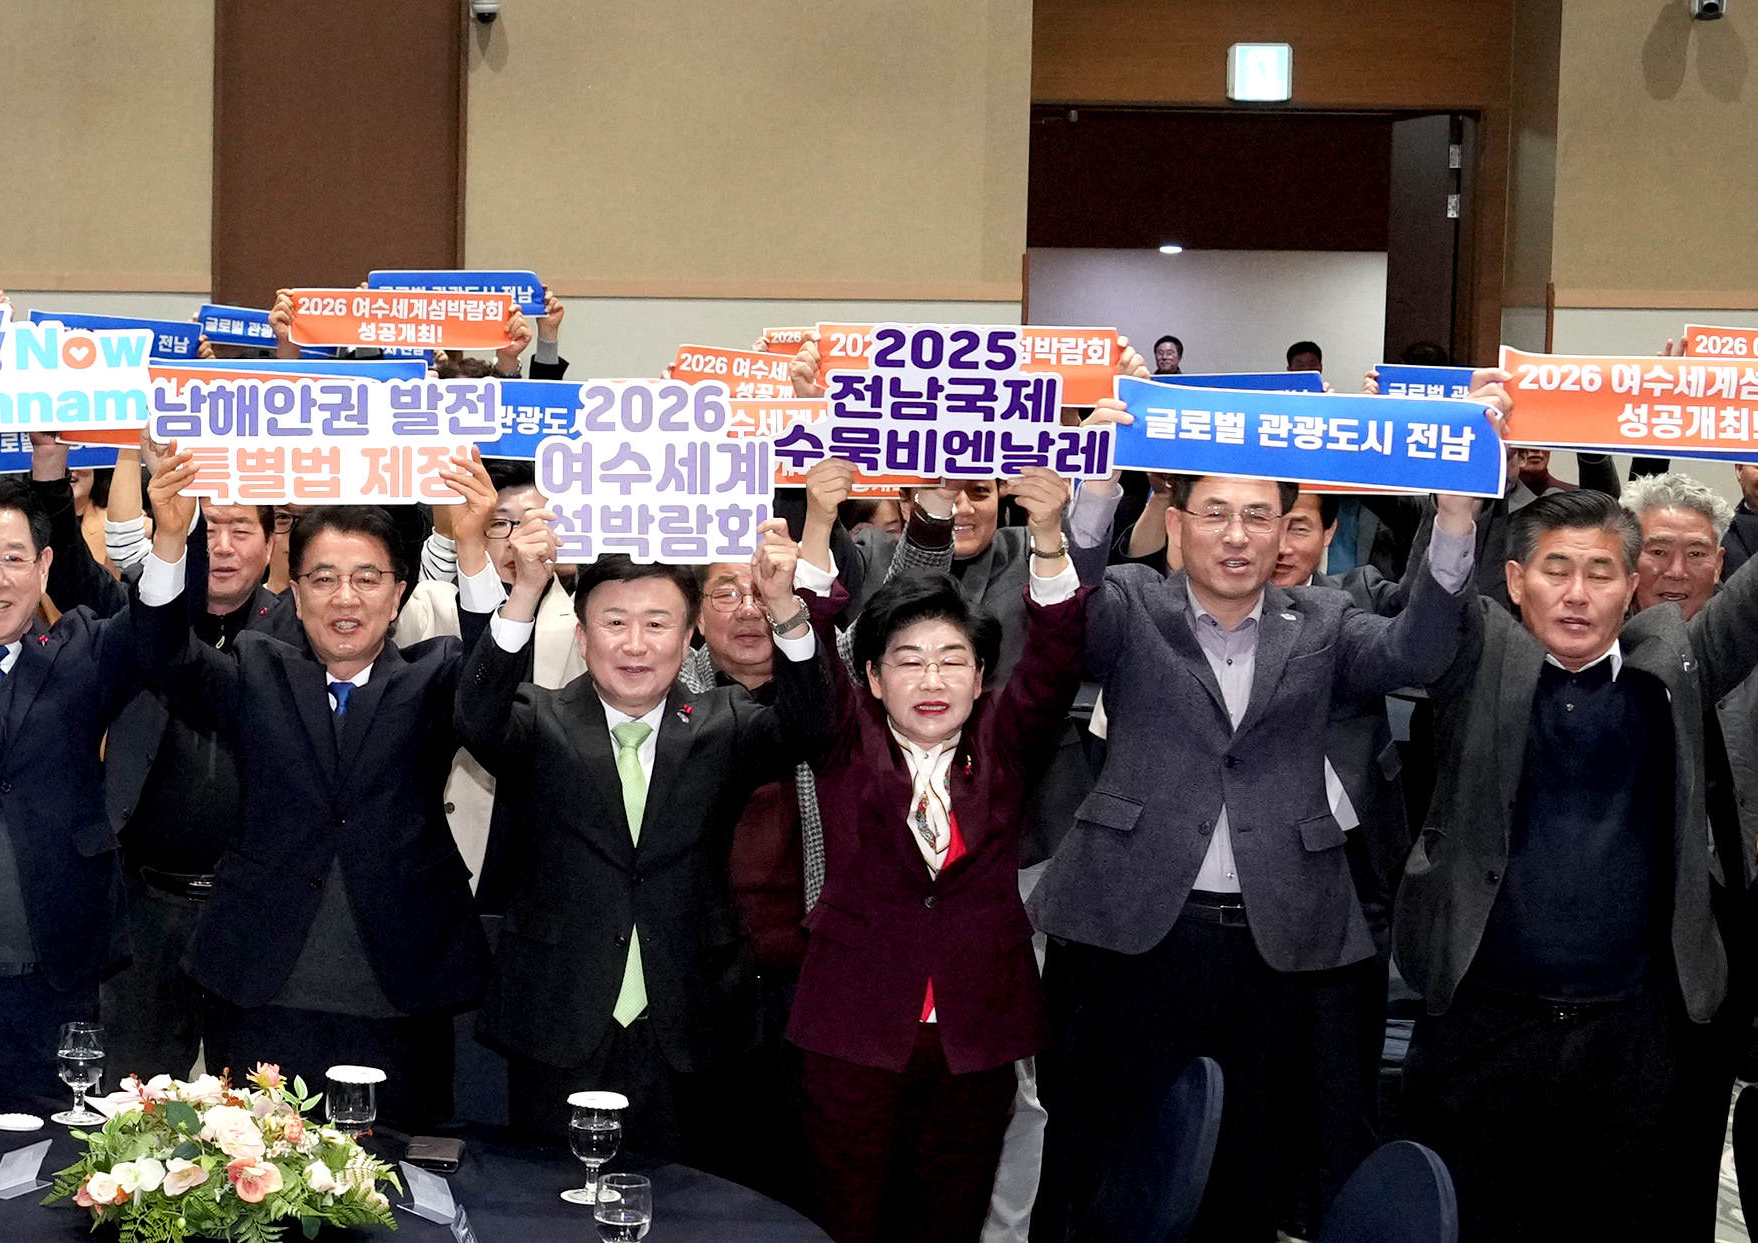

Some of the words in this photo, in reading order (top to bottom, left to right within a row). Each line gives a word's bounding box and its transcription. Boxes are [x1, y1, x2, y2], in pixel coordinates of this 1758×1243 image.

[206, 317, 244, 335] 글로벌
[298, 298, 346, 315] 2026
[353, 297, 503, 322] 여수세계섬박람회
[158, 335, 189, 354] 전남
[358, 322, 443, 343] 성공개최!
[771, 332, 801, 343] 2026
[875, 328, 1017, 370] 2025
[1695, 335, 1747, 356] 2026
[679, 353, 728, 374] 2026
[1518, 364, 1602, 392] 2026
[154, 383, 369, 437] 남해안권
[391, 383, 496, 436] 발전
[585, 385, 725, 432] 2026
[831, 375, 1058, 423] 전남국제
[774, 424, 1110, 475] 수묵비엔날레
[1145, 408, 1246, 445] 글로벌
[1258, 414, 1394, 456] 관광도시
[1405, 422, 1476, 462] 전남
[185, 445, 341, 499] 특별법
[542, 441, 768, 495] 여수세계
[549, 504, 767, 557] 섬박람회
